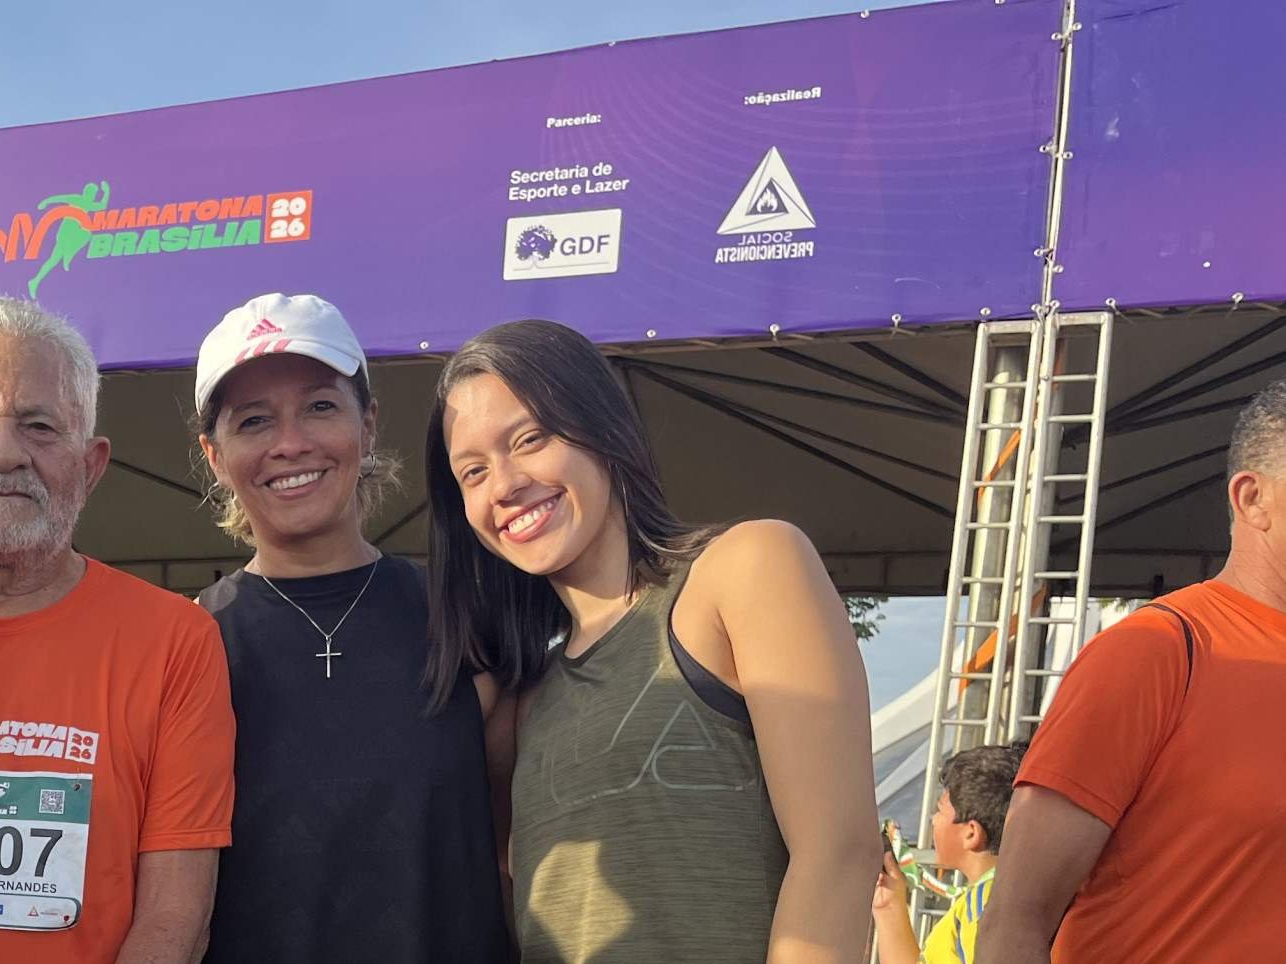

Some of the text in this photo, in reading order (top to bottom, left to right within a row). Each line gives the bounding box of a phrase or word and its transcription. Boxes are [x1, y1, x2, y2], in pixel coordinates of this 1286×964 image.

[546, 113, 602, 128] Parceria:
[510, 162, 613, 184] Secretaria de
[508, 179, 630, 201] Esporte e Lazer
[93, 195, 263, 230] MARATONA
[560, 235, 611, 256] GDF
